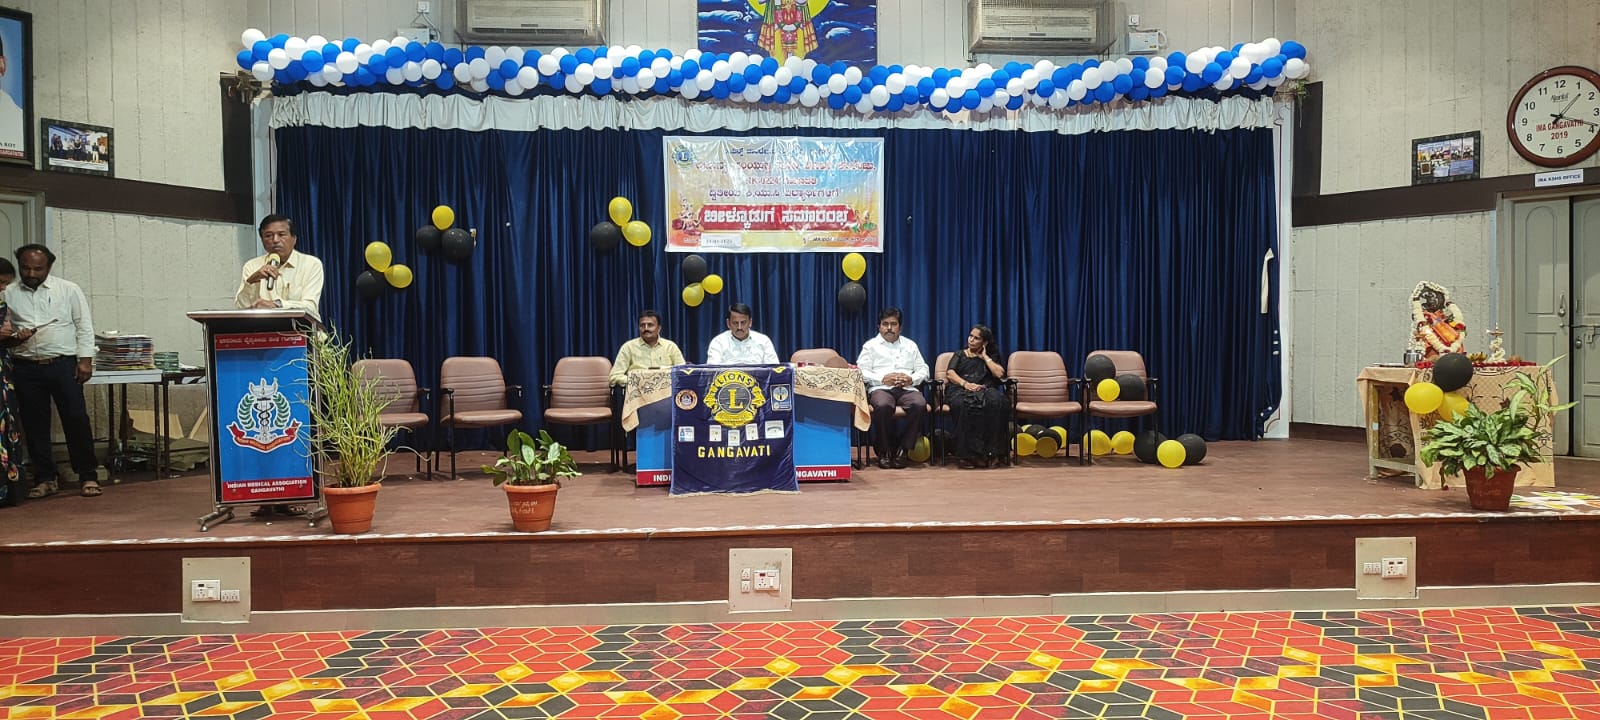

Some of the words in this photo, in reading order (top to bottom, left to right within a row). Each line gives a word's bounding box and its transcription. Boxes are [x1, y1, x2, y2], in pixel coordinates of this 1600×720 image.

[1555, 80, 1566, 88] 12
[1538, 87, 1547, 95] 11
[1588, 92, 1595, 100] 2
[1525, 102, 1535, 110] 10
[1593, 108, 1599, 116] 3
[1522, 118, 1528, 126] 9
[1588, 125, 1594, 133] 4
[1551, 131, 1568, 140] 2019
[1575, 139, 1581, 147] 5
[1557, 146, 1563, 154] 6
[717, 372, 754, 386] LIONS
[728, 388, 744, 409] L
[697, 445, 771, 458] GANGAVATI
[653, 474, 671, 482] INDI
[796, 469, 837, 478] NGAVATHI
